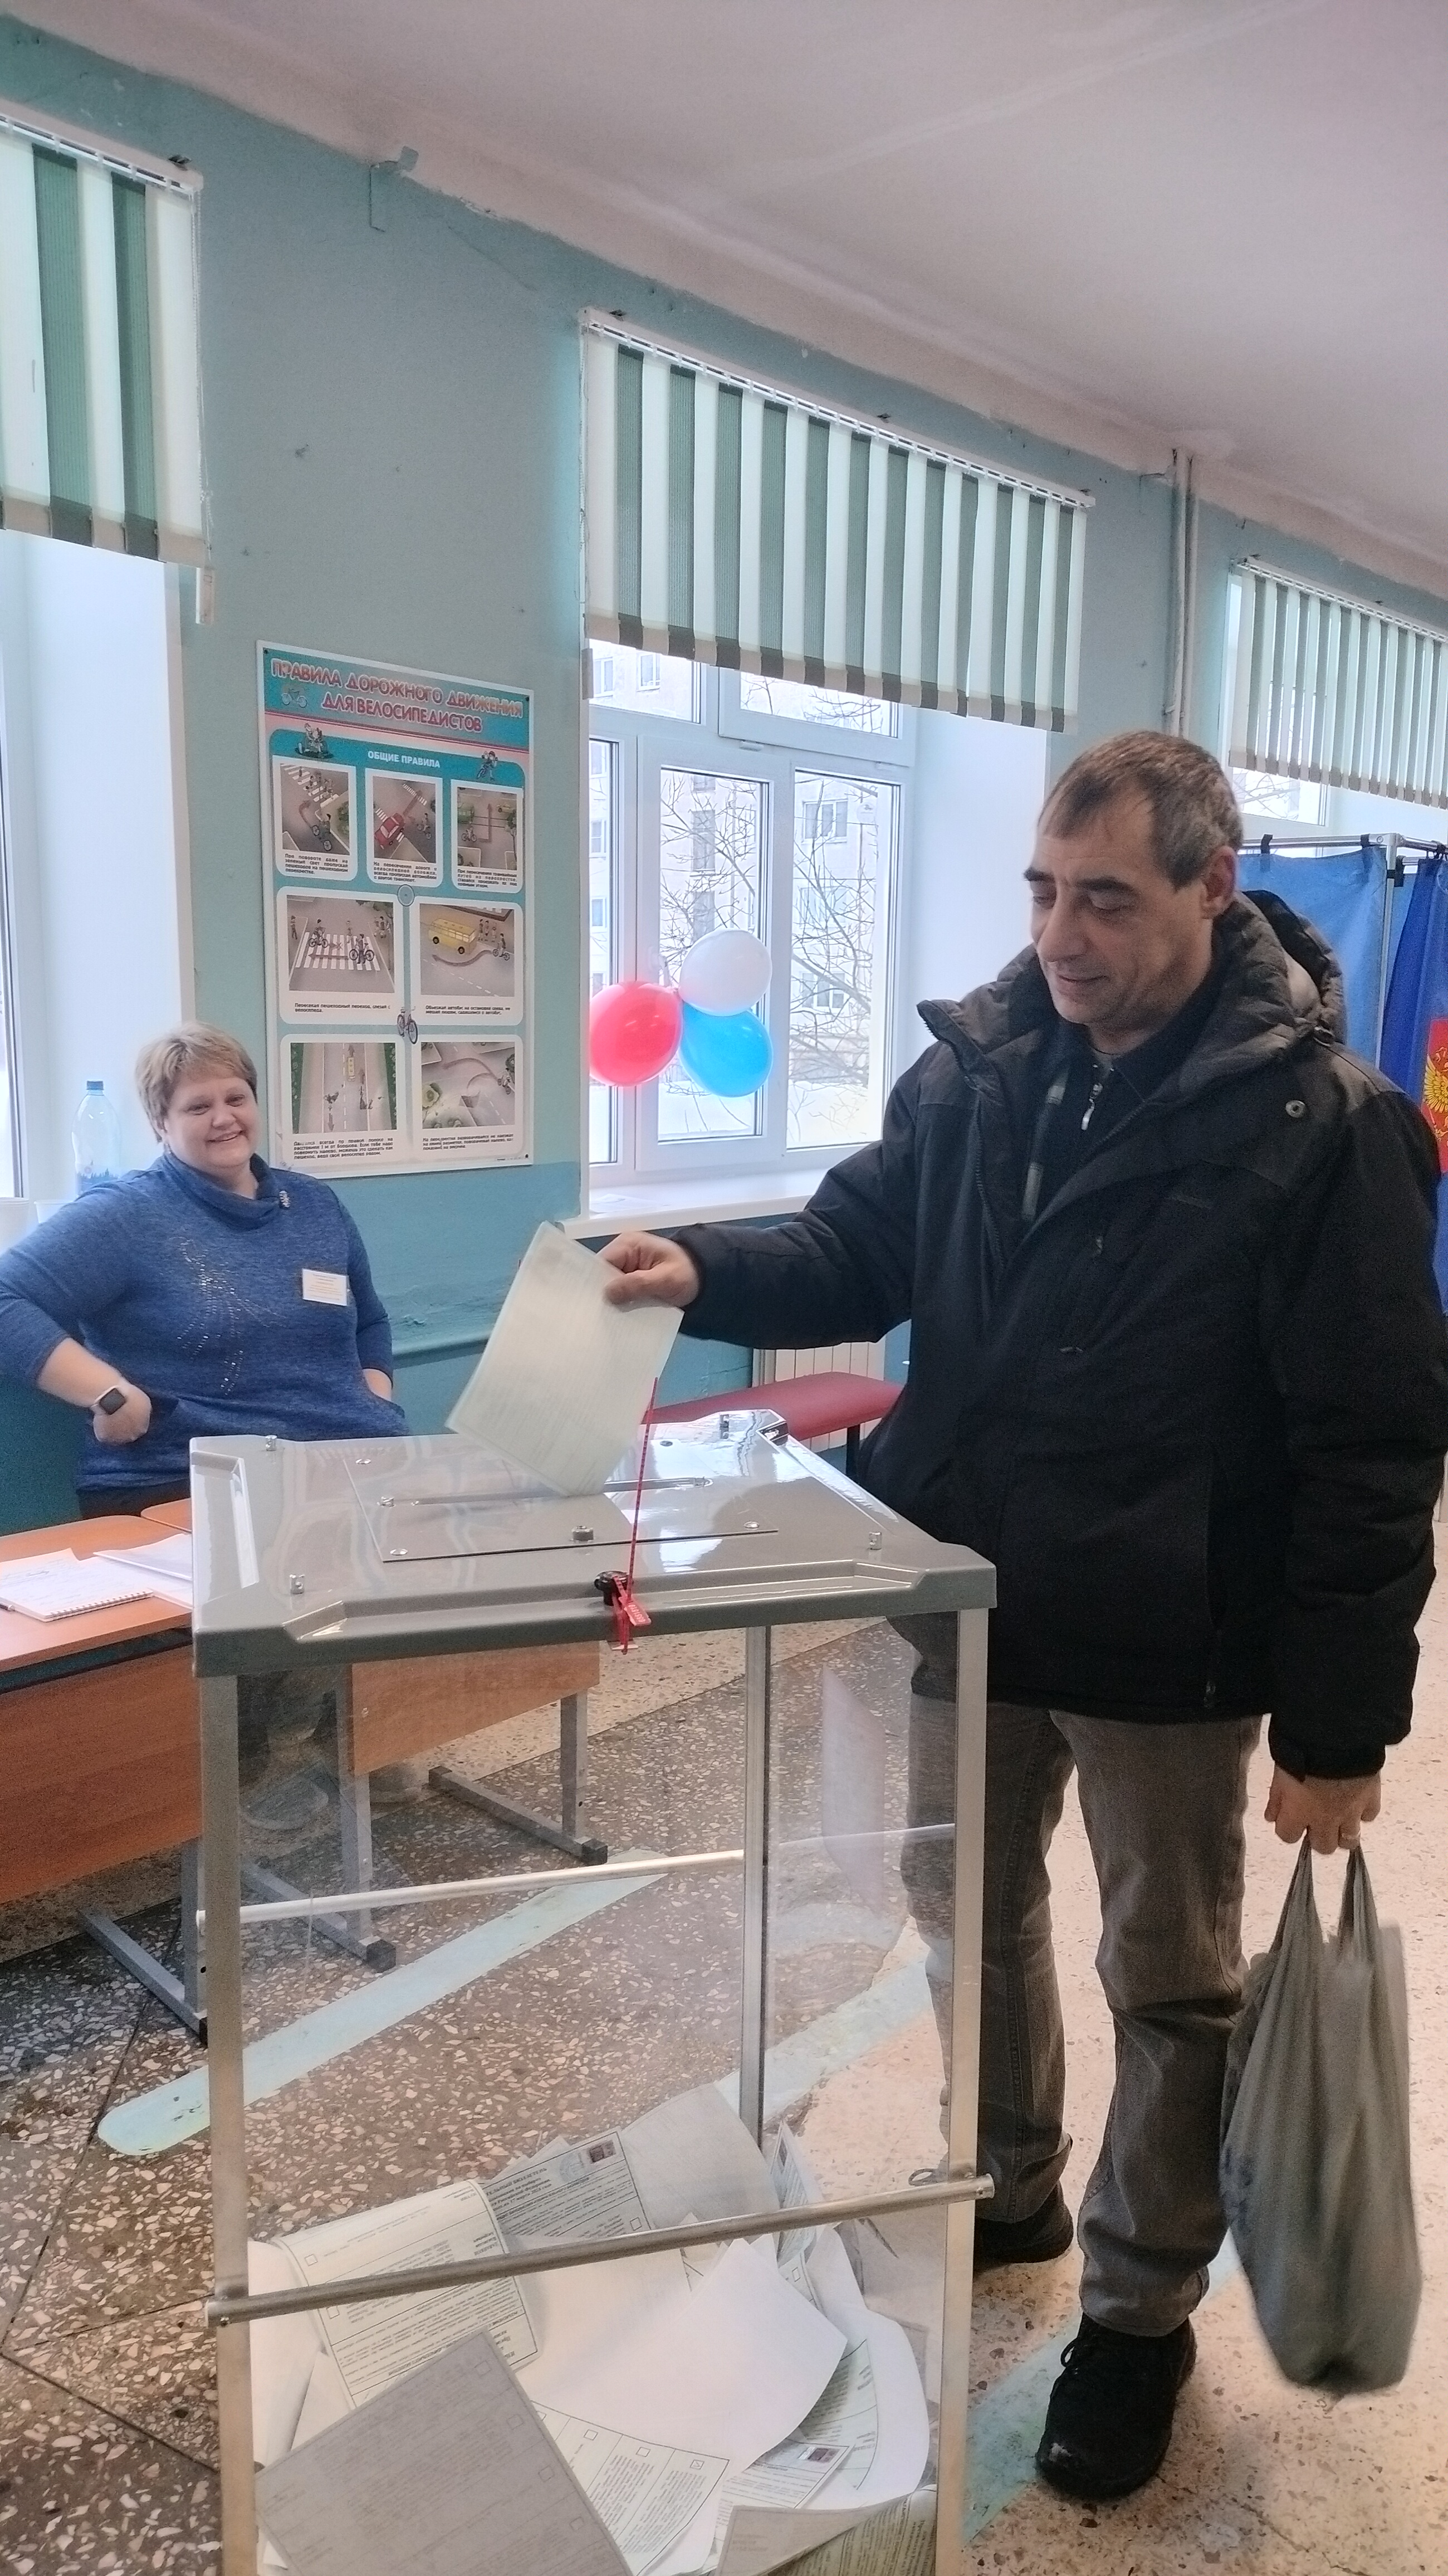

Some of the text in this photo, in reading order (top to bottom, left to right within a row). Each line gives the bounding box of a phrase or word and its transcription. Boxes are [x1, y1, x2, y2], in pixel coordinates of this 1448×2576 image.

[271, 658, 524, 719] ПРАВИЛА ДОРОЖНОГО ДВИЖЕНИЯ
[321, 691, 482, 734] ДЛЯ ВЕЛОСИПЕДИСТОВ
[368, 750, 441, 768] ОБЩИЕ ПРАВИЛА
